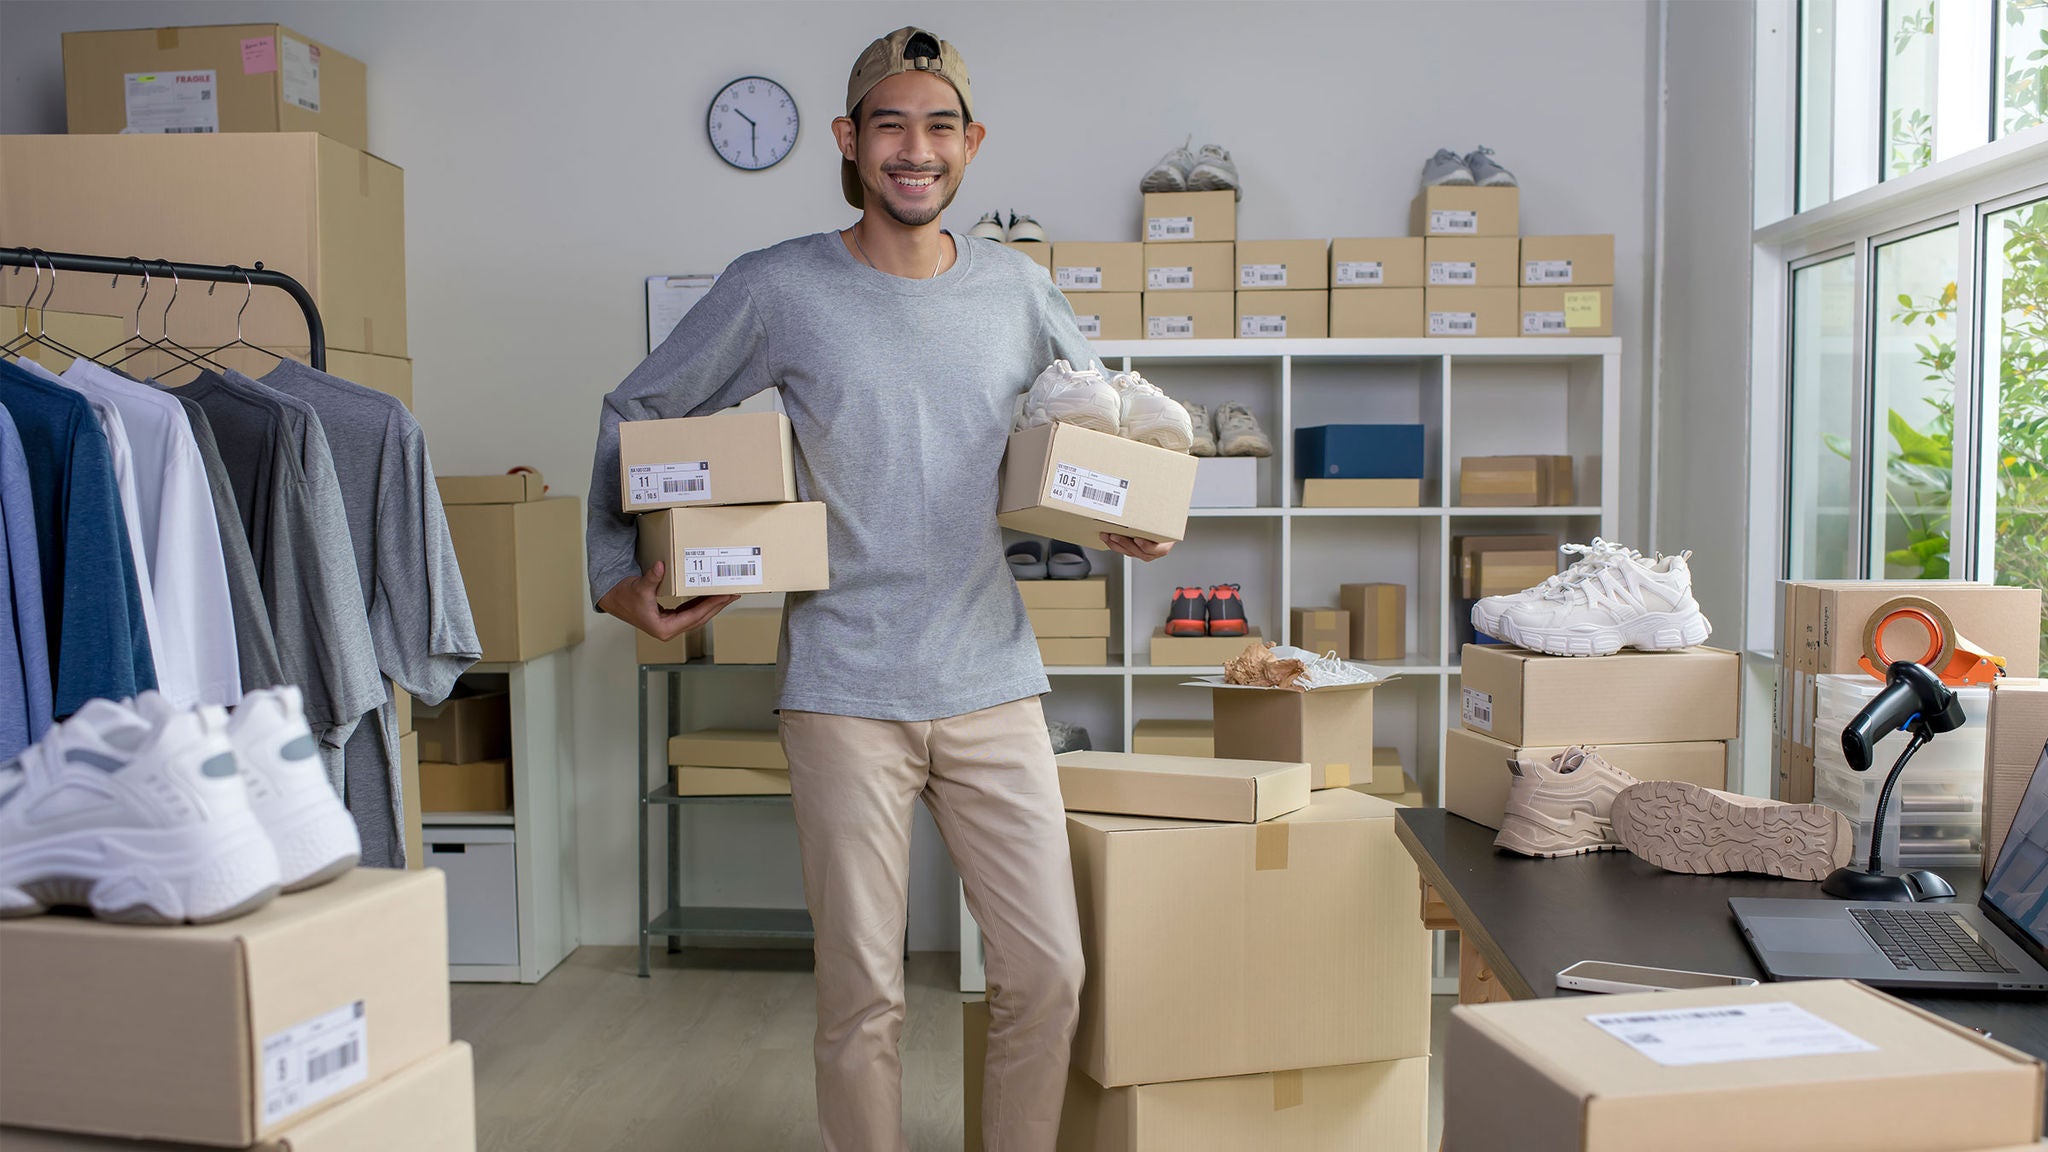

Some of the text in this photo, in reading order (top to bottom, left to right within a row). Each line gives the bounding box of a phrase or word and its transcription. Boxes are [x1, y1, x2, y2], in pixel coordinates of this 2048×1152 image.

[175, 74, 210, 84] FRAGILE
[720, 104, 729, 113] 10
[779, 99, 786, 108] 2
[639, 476, 650, 488] 11
[1059, 473, 1077, 488] 10.5
[646, 492, 658, 500] 10.5
[693, 559, 704, 571] 11
